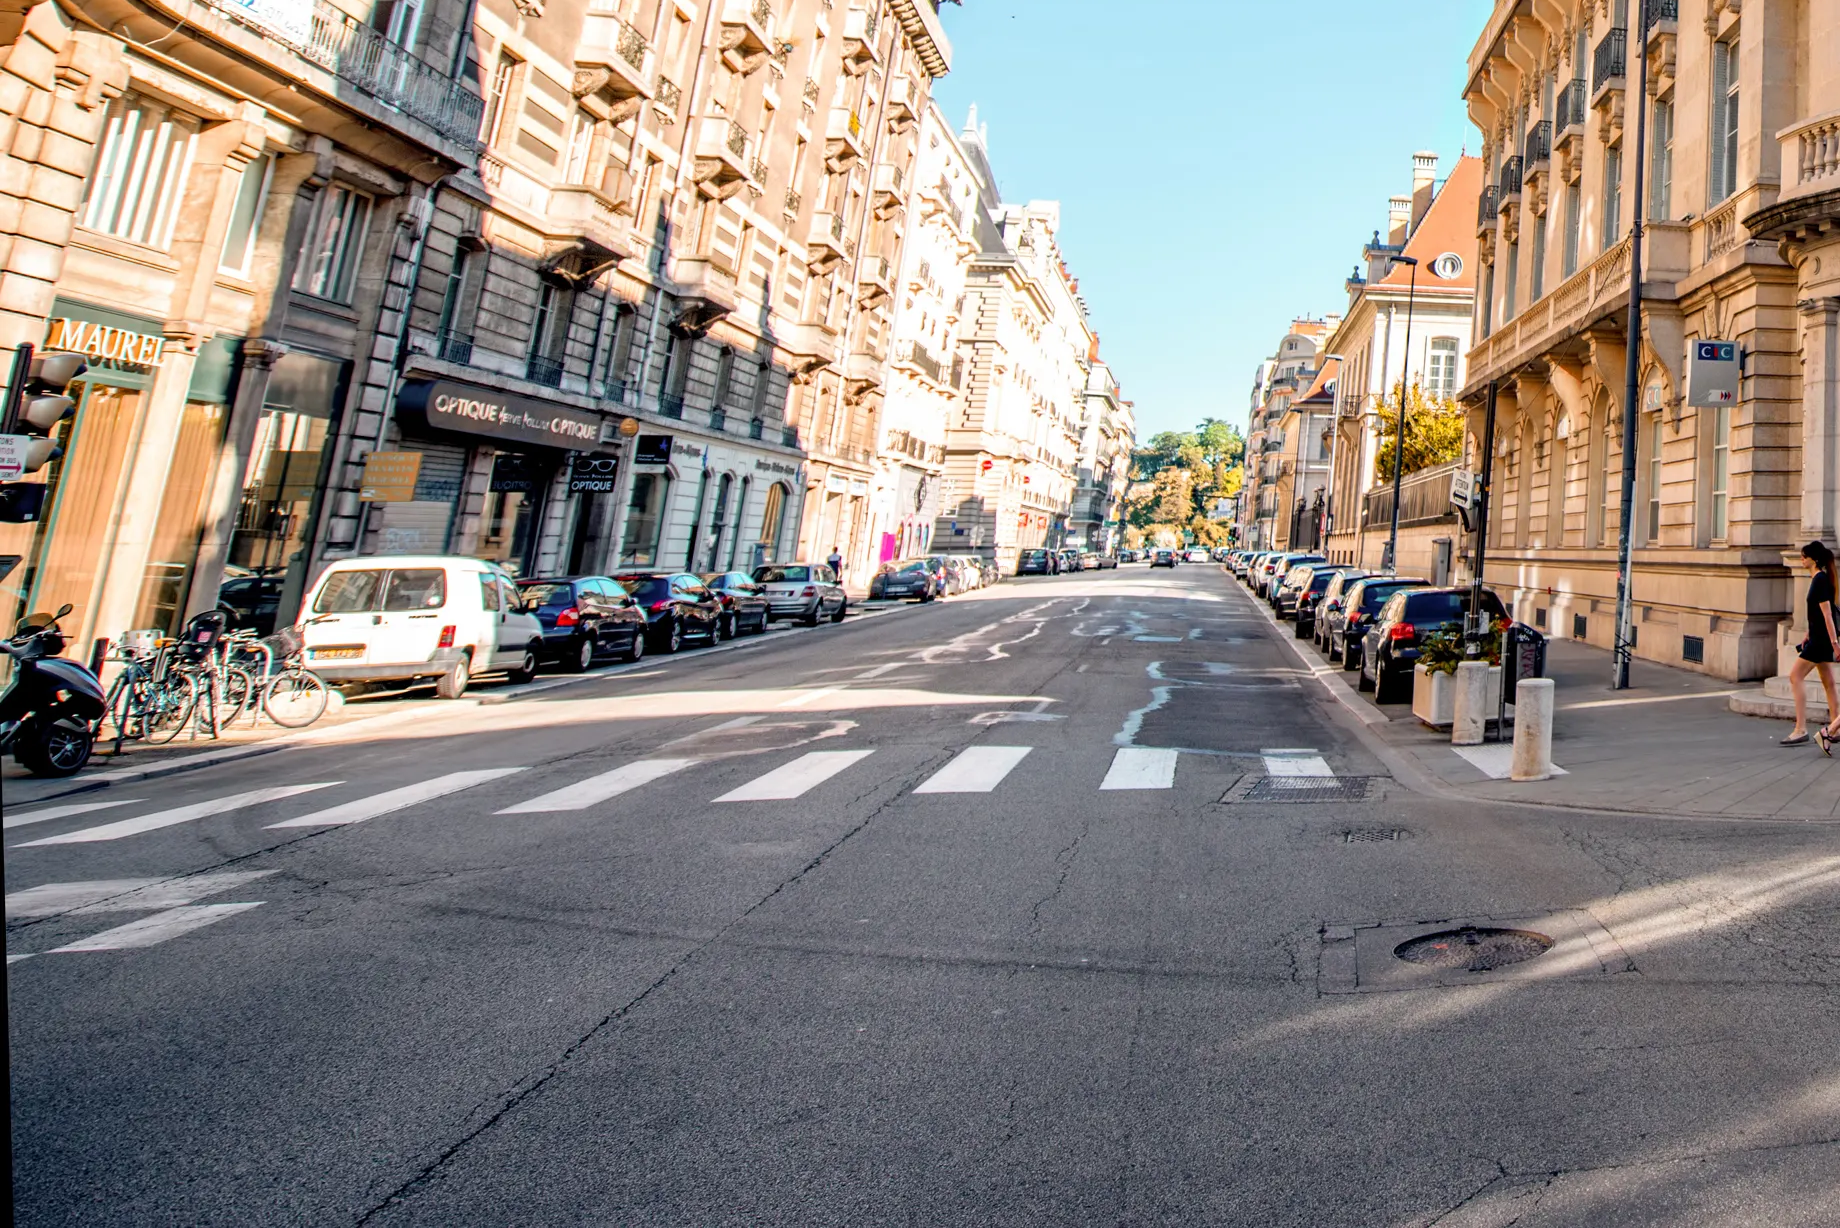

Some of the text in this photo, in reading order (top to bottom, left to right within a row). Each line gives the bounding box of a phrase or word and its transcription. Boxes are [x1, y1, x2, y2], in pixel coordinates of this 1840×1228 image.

[55, 317, 167, 368] MAUREL
[434, 393, 498, 421] OPTIQUE
[551, 417, 598, 440] OPTIQUE
[571, 481, 612, 491] OPTIQUE
